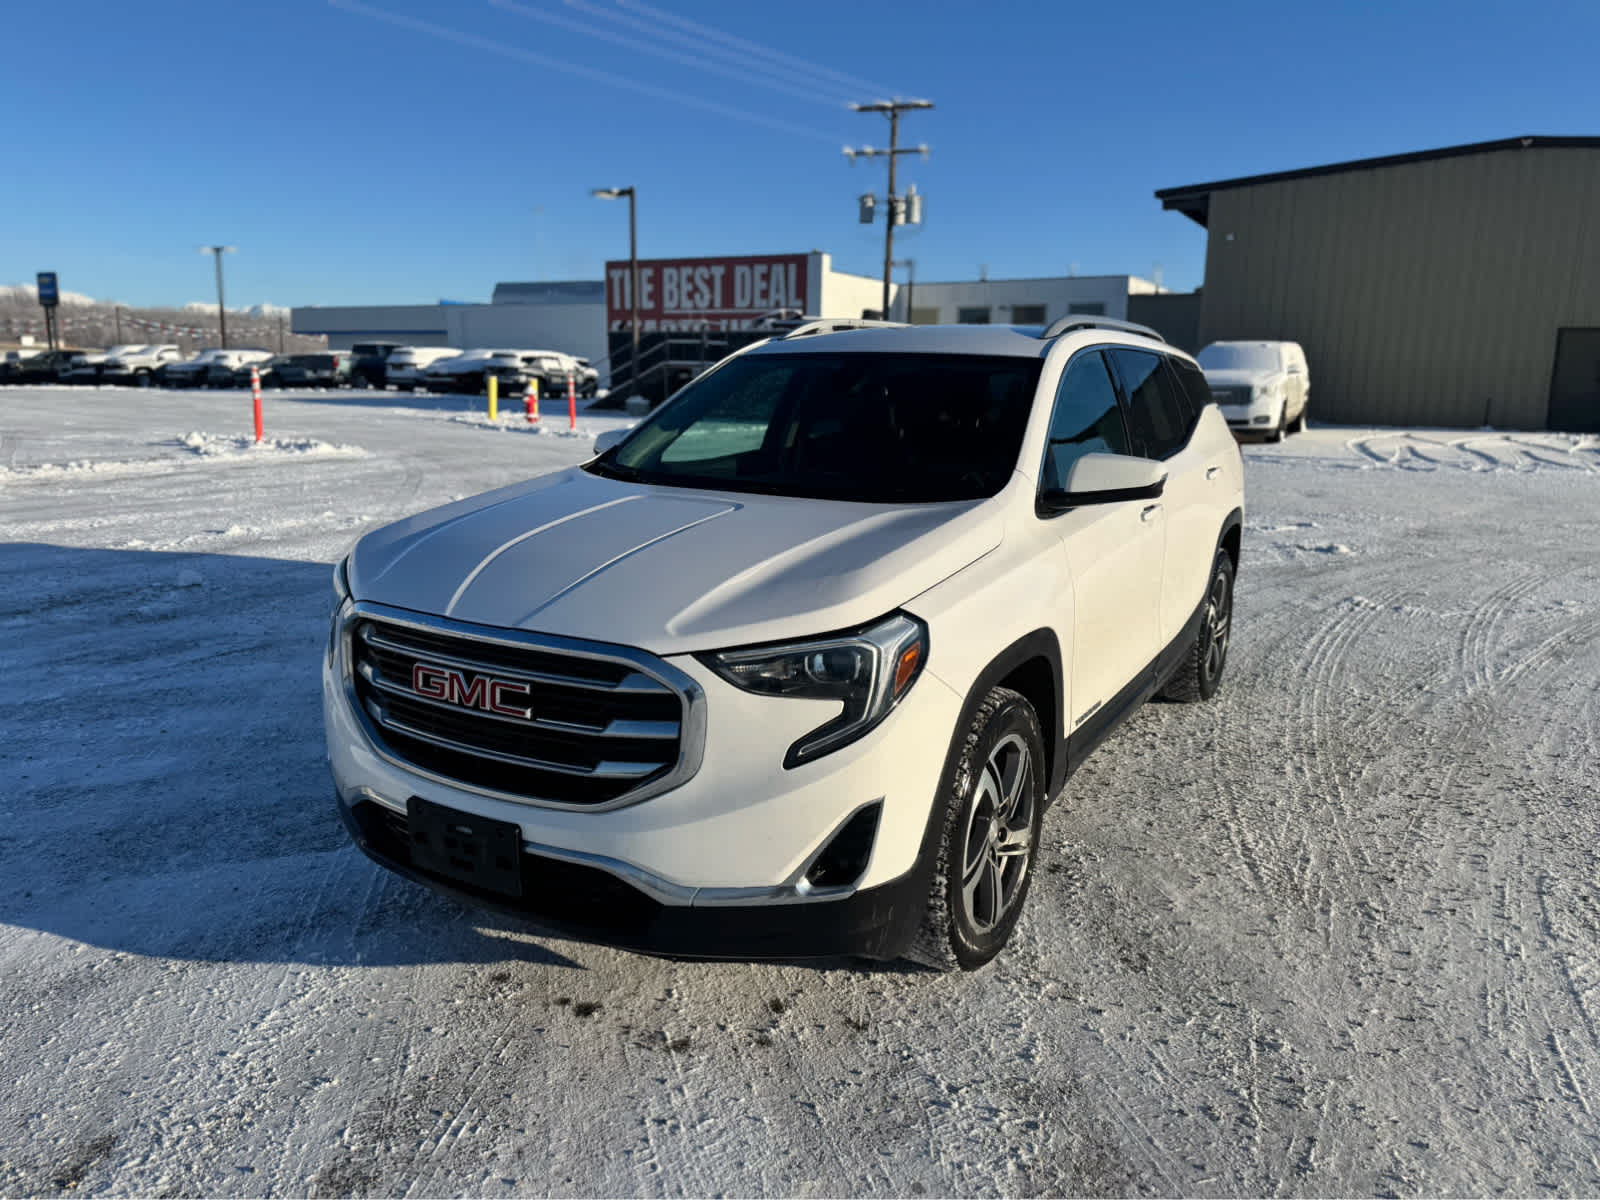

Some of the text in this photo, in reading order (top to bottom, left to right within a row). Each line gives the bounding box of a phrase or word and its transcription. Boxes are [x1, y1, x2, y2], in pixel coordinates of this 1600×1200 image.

[663, 264, 725, 308] BEST
[734, 263, 803, 308] DEAL
[413, 663, 532, 720] GMC
